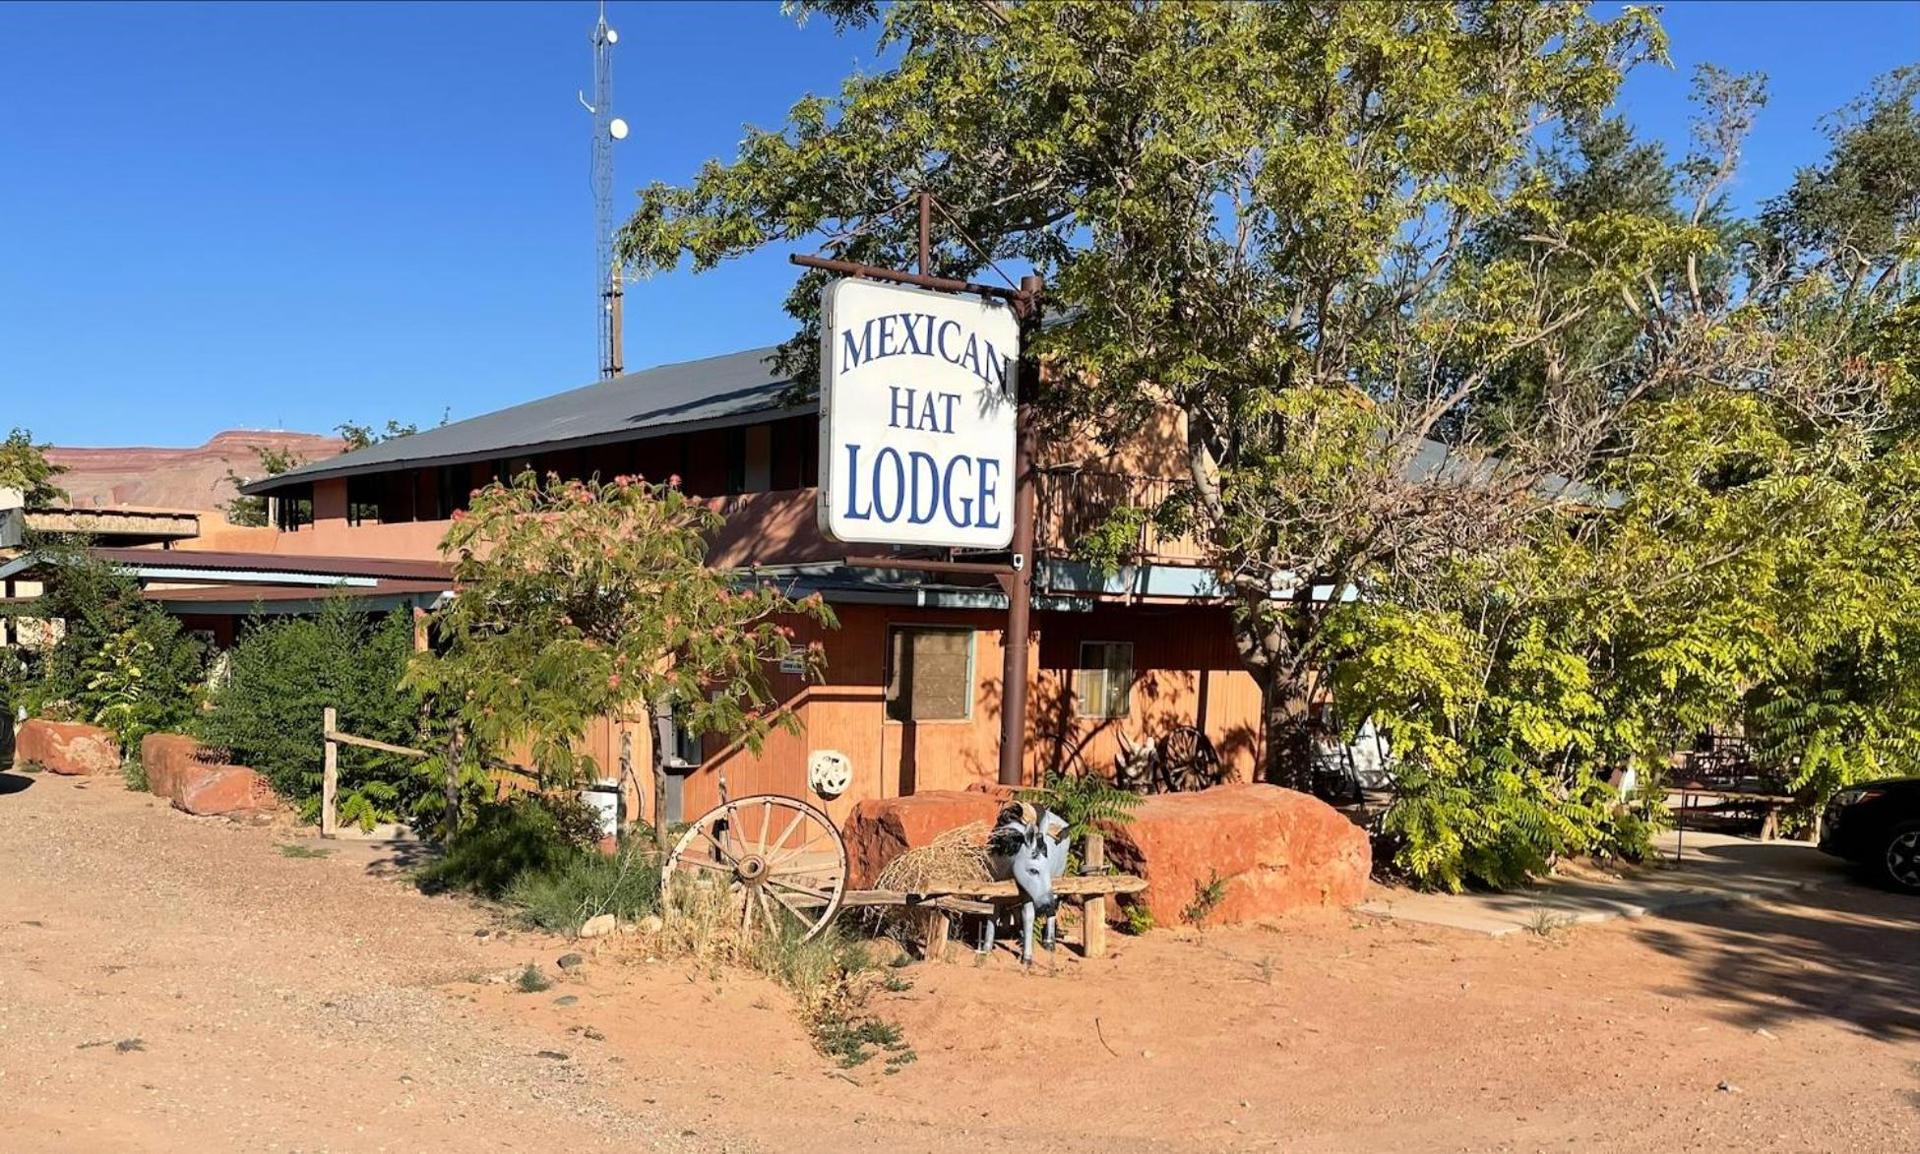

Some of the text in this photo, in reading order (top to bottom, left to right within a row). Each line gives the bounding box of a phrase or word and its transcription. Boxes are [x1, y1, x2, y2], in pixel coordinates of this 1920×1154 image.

[841, 313, 1010, 395] MEXICAN
[888, 386, 960, 434] HAT
[844, 444, 1000, 529] LODGE
